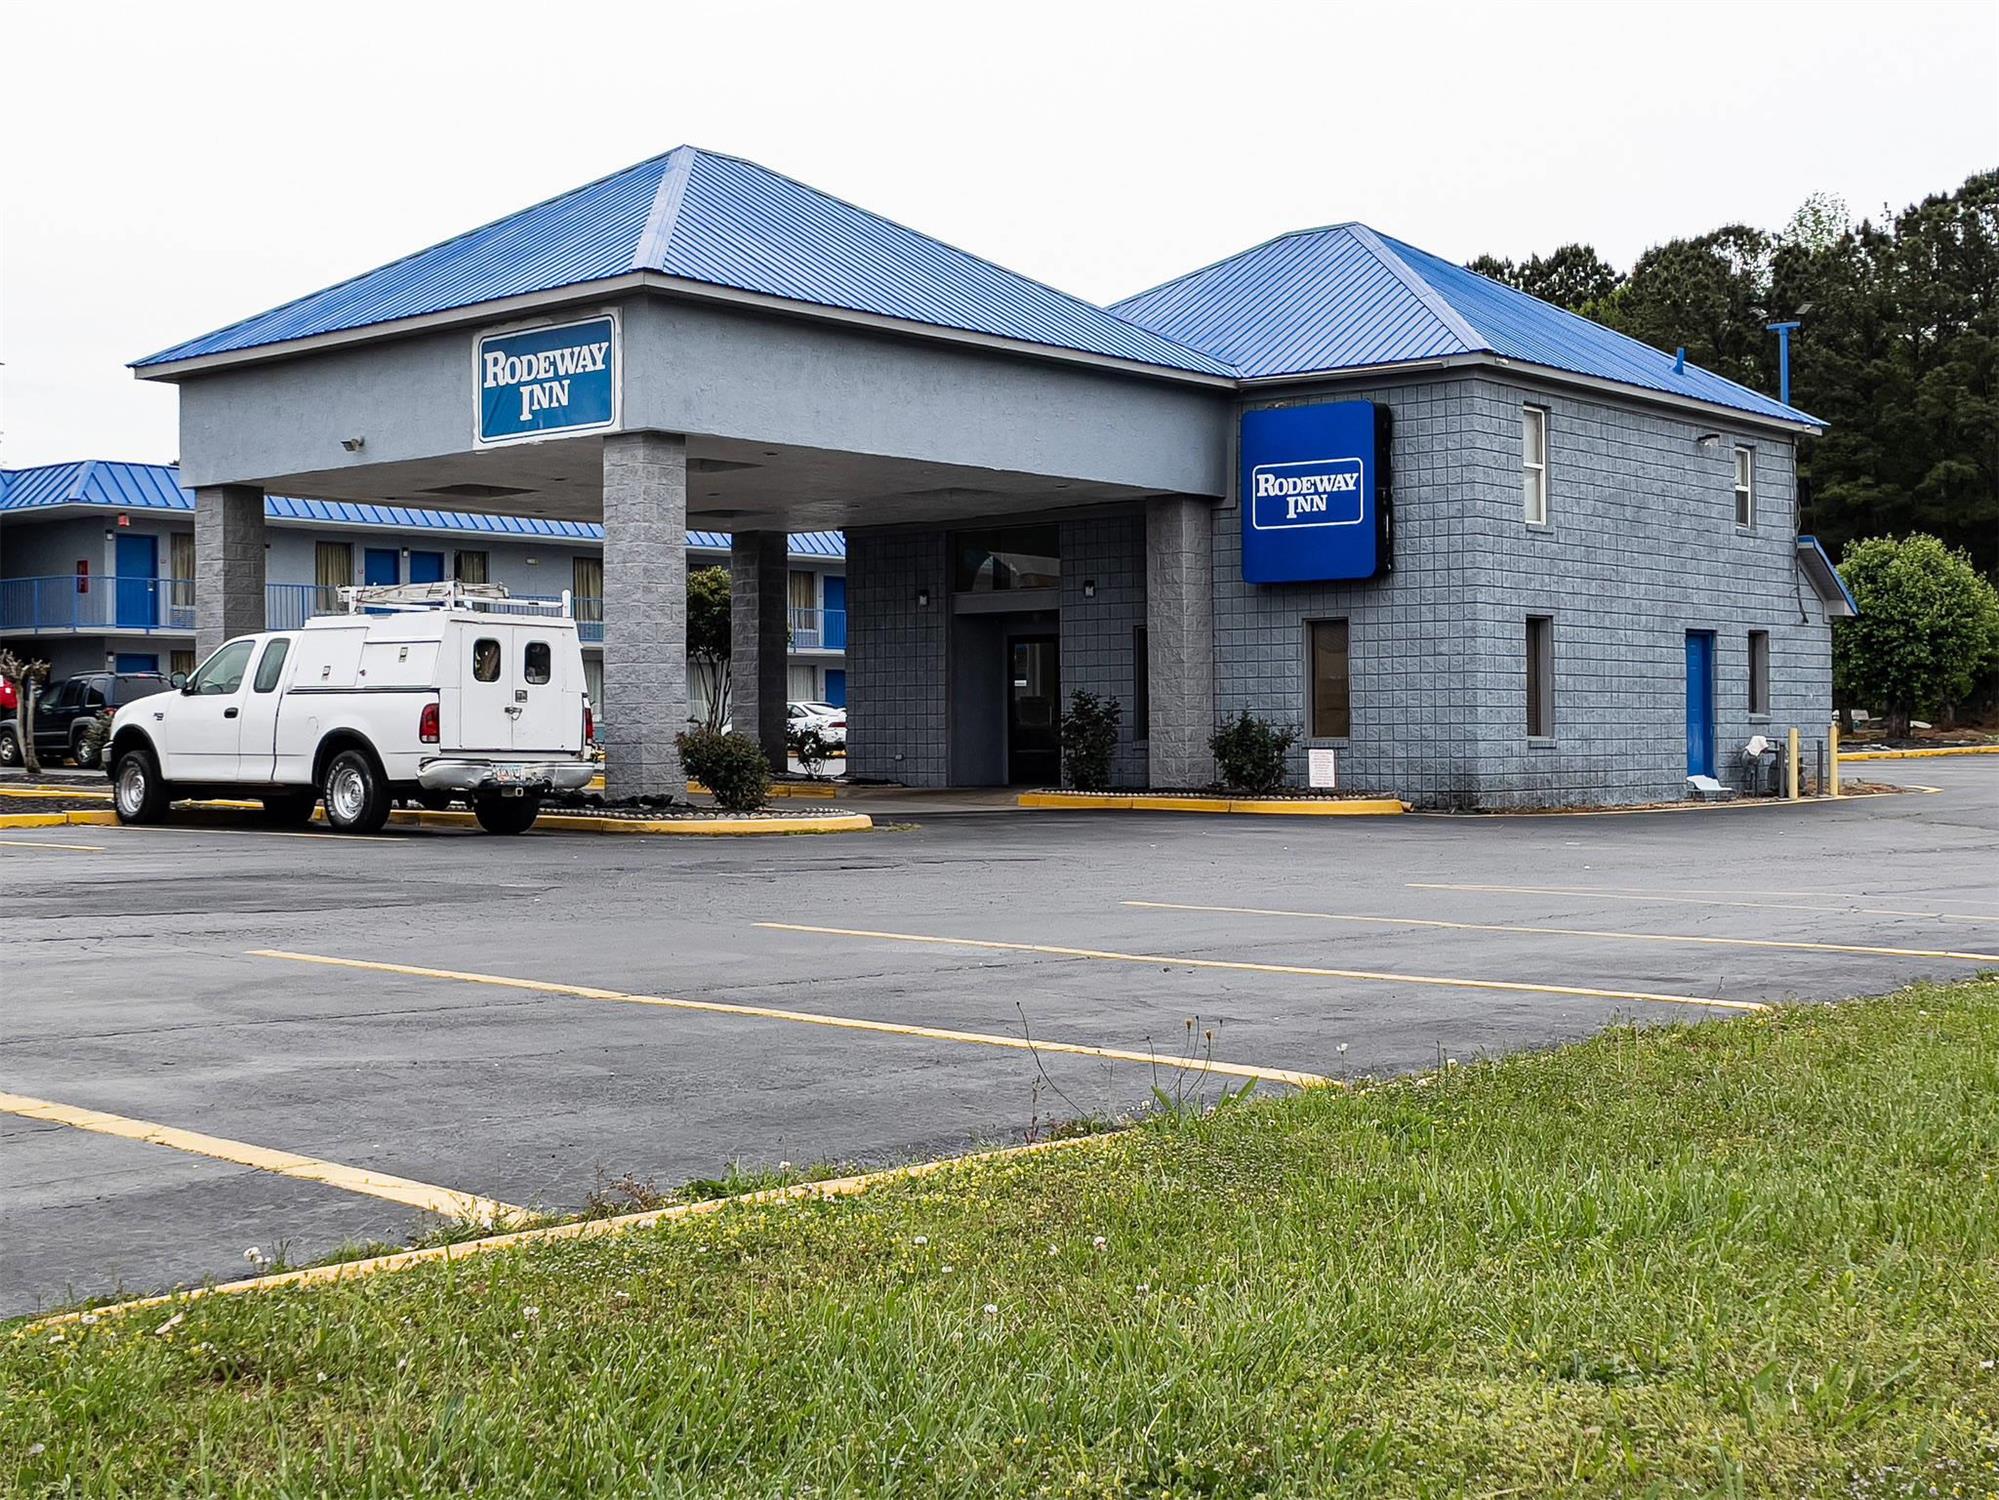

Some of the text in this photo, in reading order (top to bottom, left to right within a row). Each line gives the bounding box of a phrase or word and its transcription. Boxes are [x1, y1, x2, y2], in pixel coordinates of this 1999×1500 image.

[483, 341, 609, 388] RODEWAY
[519, 379, 570, 421] INN
[1256, 472, 1359, 497] RODEWAY
[1286, 494, 1328, 519] INN
